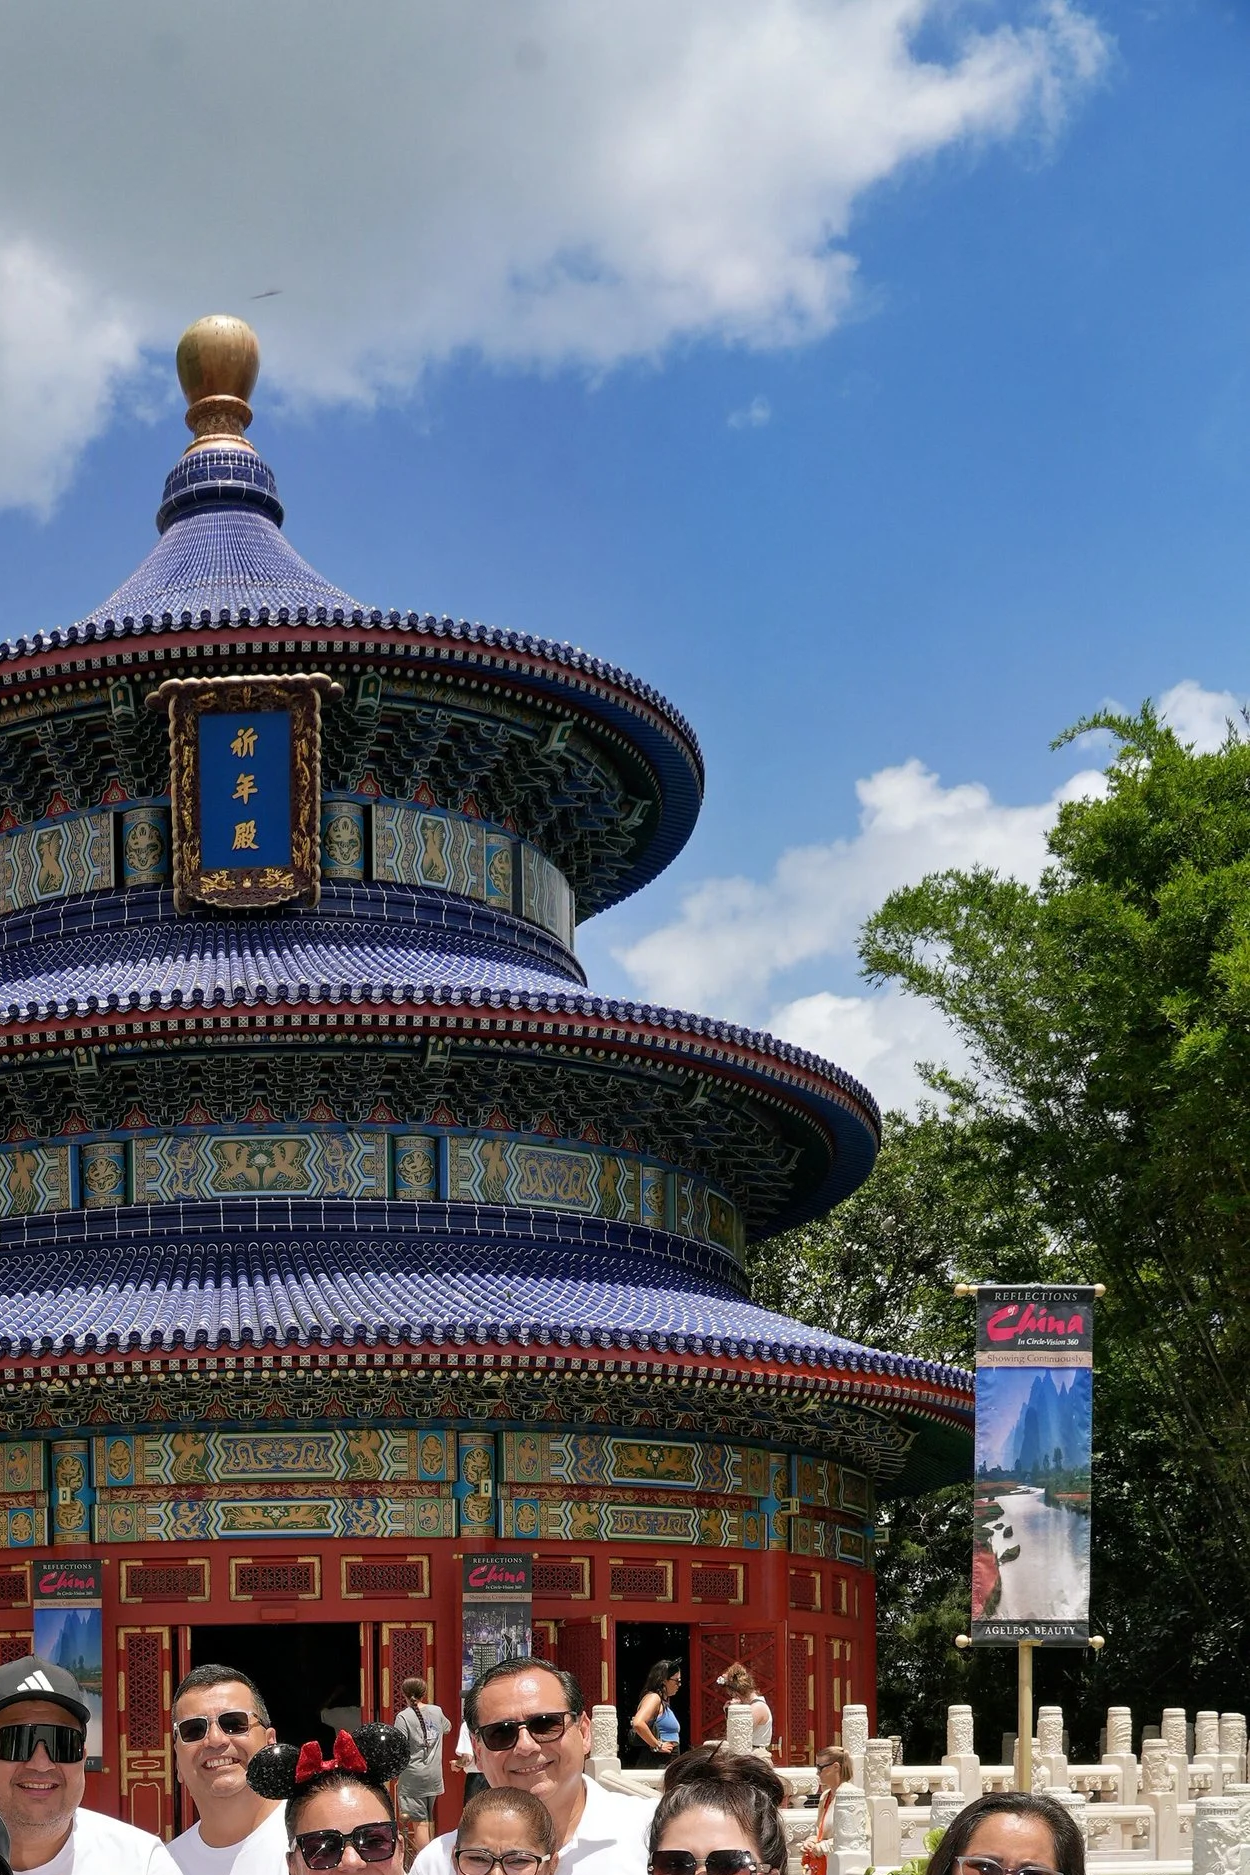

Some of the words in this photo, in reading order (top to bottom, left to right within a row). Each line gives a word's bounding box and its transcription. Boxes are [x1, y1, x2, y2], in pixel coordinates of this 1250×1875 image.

[230, 727, 259, 851] 祈年殿
[994, 1292, 1078, 1301] REFLECTIONS
[986, 1303, 1084, 1341] China
[1026, 1338, 1066, 1346] Circle-Vision
[1066, 1338, 1079, 1346] 360
[987, 1354, 1025, 1364] Showing
[1027, 1354, 1083, 1364] Continuously
[38, 1570, 95, 1593] China
[468, 1564, 526, 1587] China
[985, 1626, 1030, 1635] AGELESS
[1034, 1626, 1076, 1635] BEAUTY
